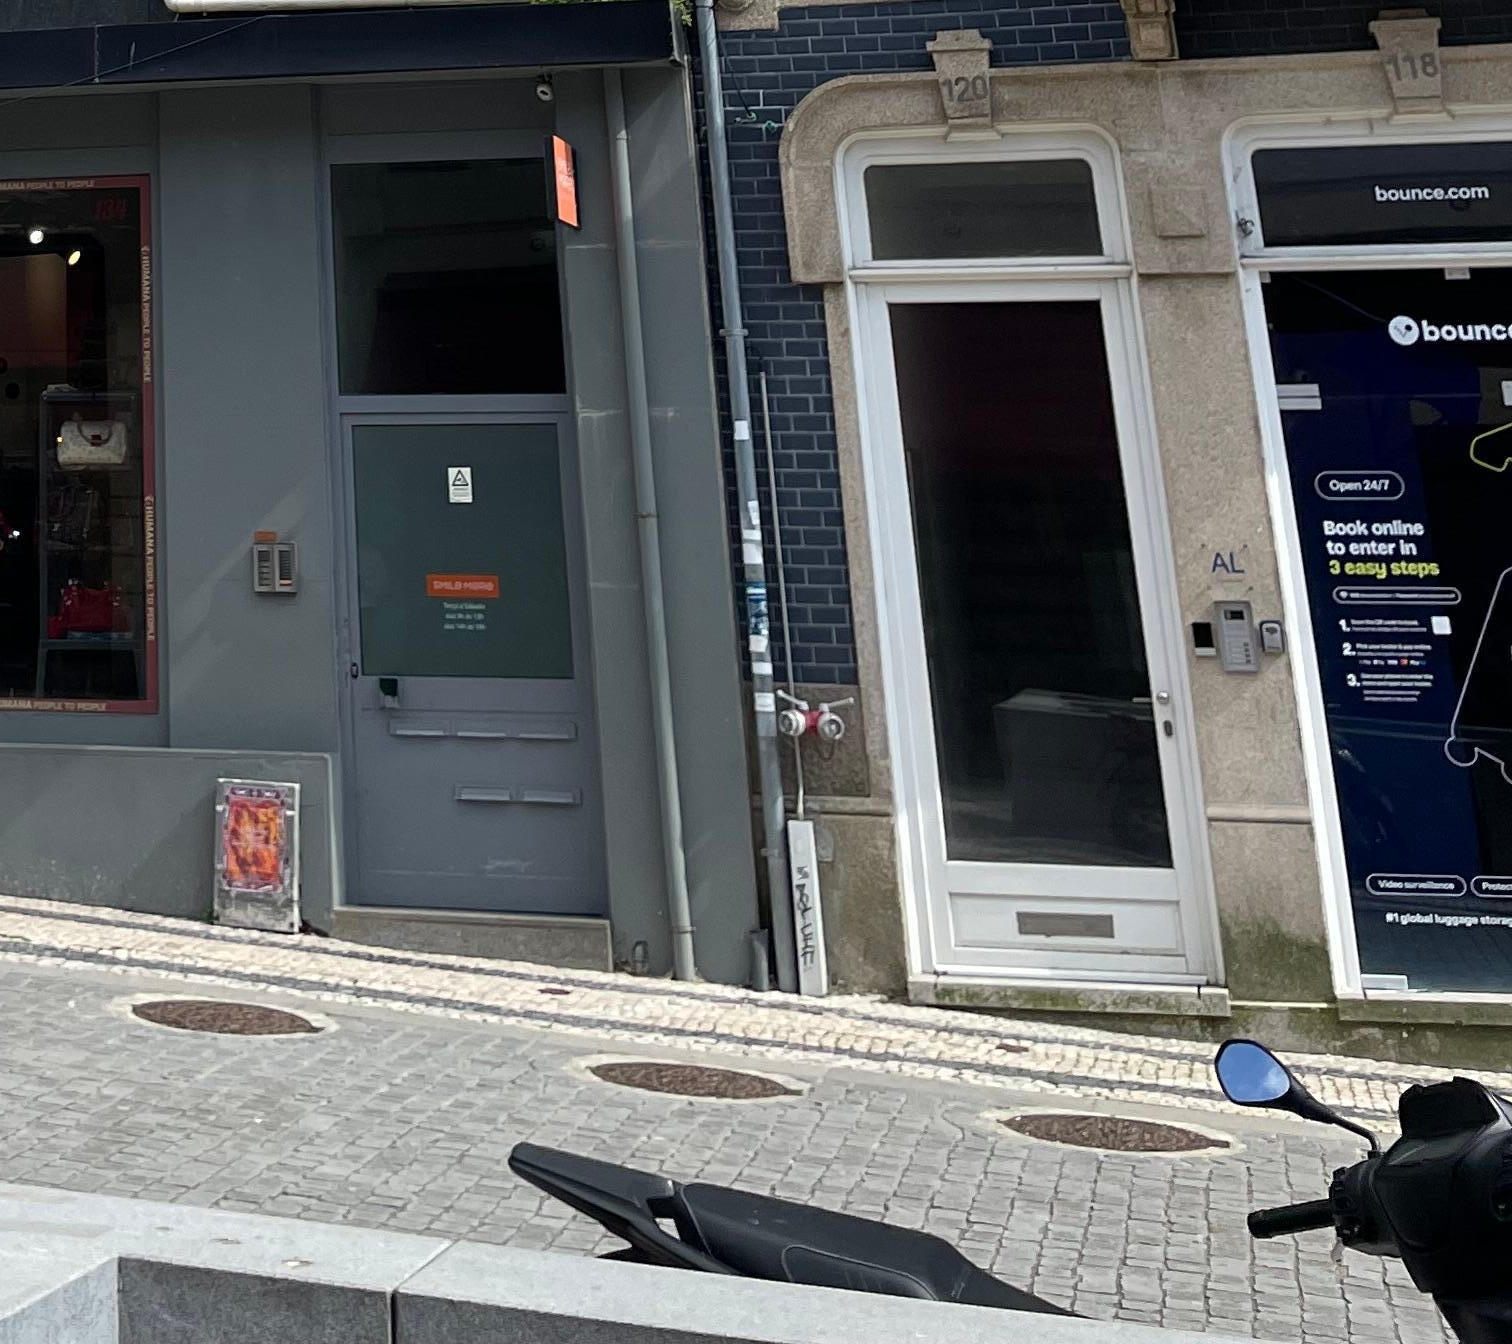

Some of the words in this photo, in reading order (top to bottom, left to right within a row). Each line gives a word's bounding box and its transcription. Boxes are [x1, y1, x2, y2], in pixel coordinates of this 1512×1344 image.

[1383, 52, 1438, 80] 118
[940, 75, 988, 102] 120
[1375, 185, 1489, 201] bounce.com
[1421, 319, 1512, 341] bounc
[1329, 479, 1362, 493] Open
[1363, 479, 1389, 491] 24/7
[1323, 520, 1368, 536] Book
[1371, 519, 1424, 536] online
[1326, 540, 1345, 555] to
[1349, 540, 1396, 555] enter
[1399, 539, 1417, 555] in
[1212, 552, 1245, 573] AL
[1329, 559, 1341, 575] 3
[1344, 562, 1387, 579] easy
[1390, 560, 1440, 578] steps
[1339, 619, 1350, 632] 1.
[1342, 642, 1356, 656] 2.
[1346, 673, 1360, 687] 3.
[1400, 913, 1433, 925] global
[1434, 914, 1478, 926] luggage
